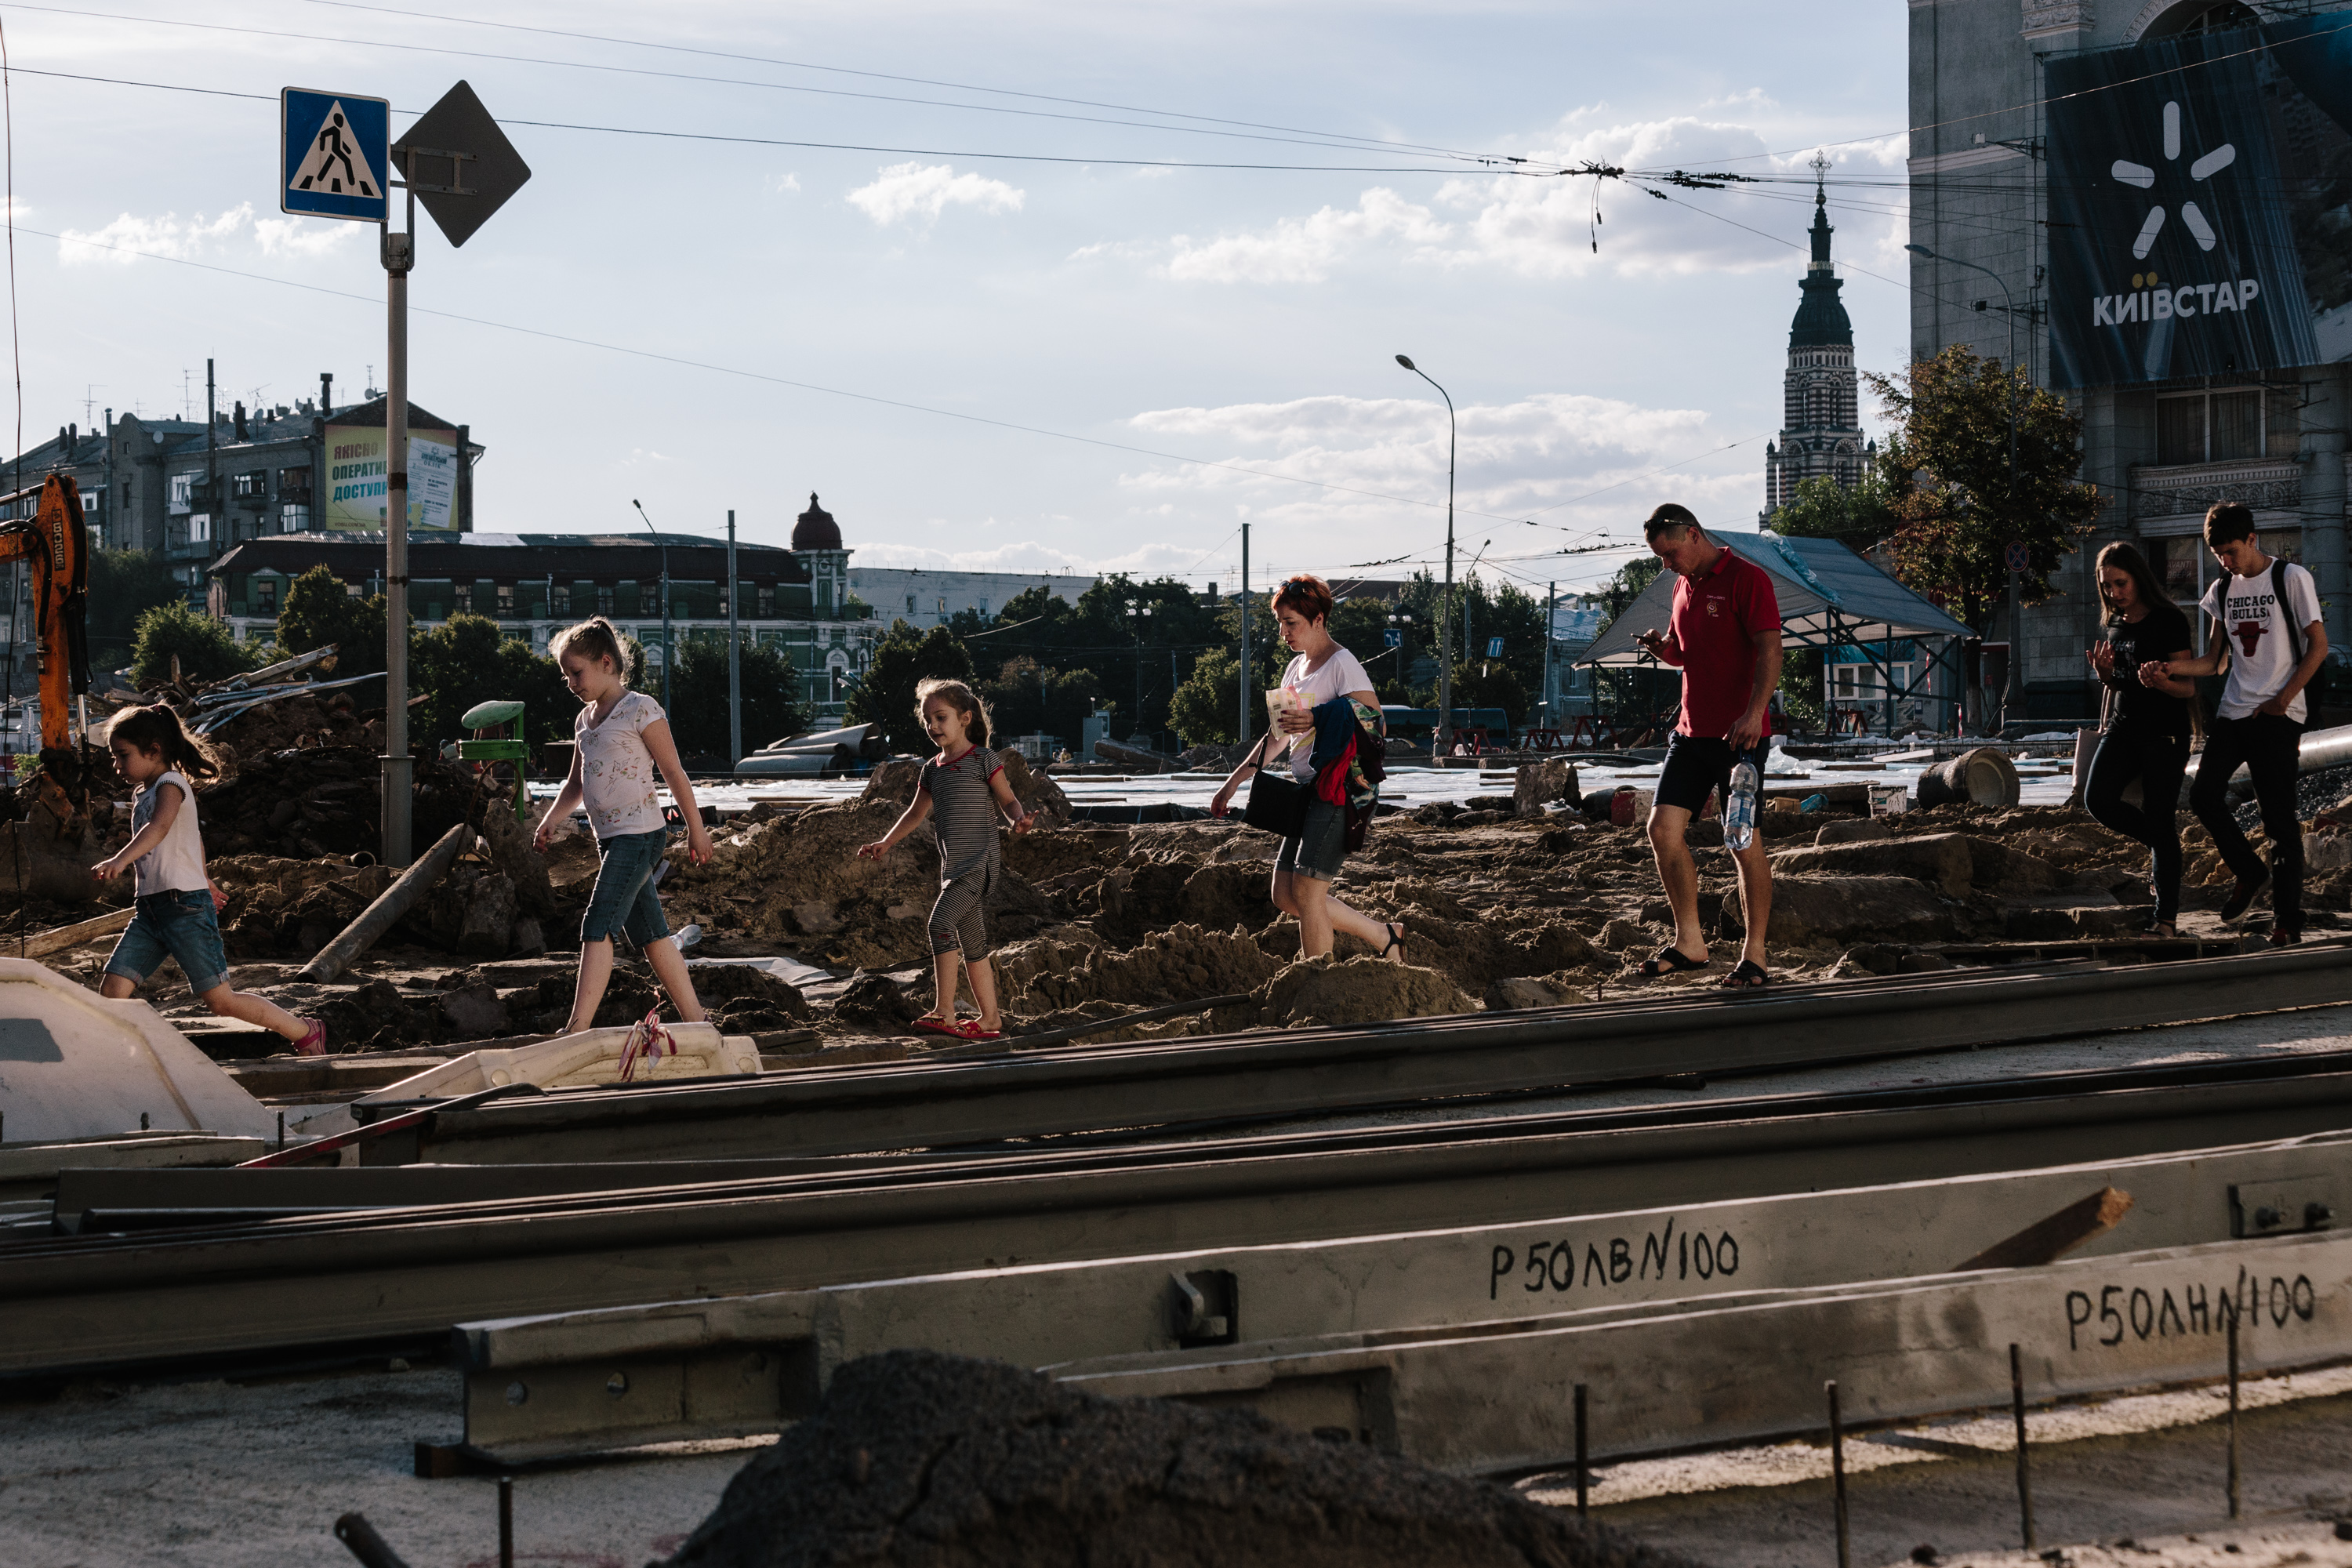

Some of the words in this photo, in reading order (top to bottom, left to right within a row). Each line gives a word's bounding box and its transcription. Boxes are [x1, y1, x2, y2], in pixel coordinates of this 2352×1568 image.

[2092, 271, 2259, 327] КИЇВСТАР
[335, 443, 377, 459] ЯКІСНО
[53, 522, 64, 564] 8026
[2166, 570, 2192, 579] ДВЕРИ
[2227, 594, 2275, 608] CHICAGO
[2231, 607, 2267, 620] BULLS
